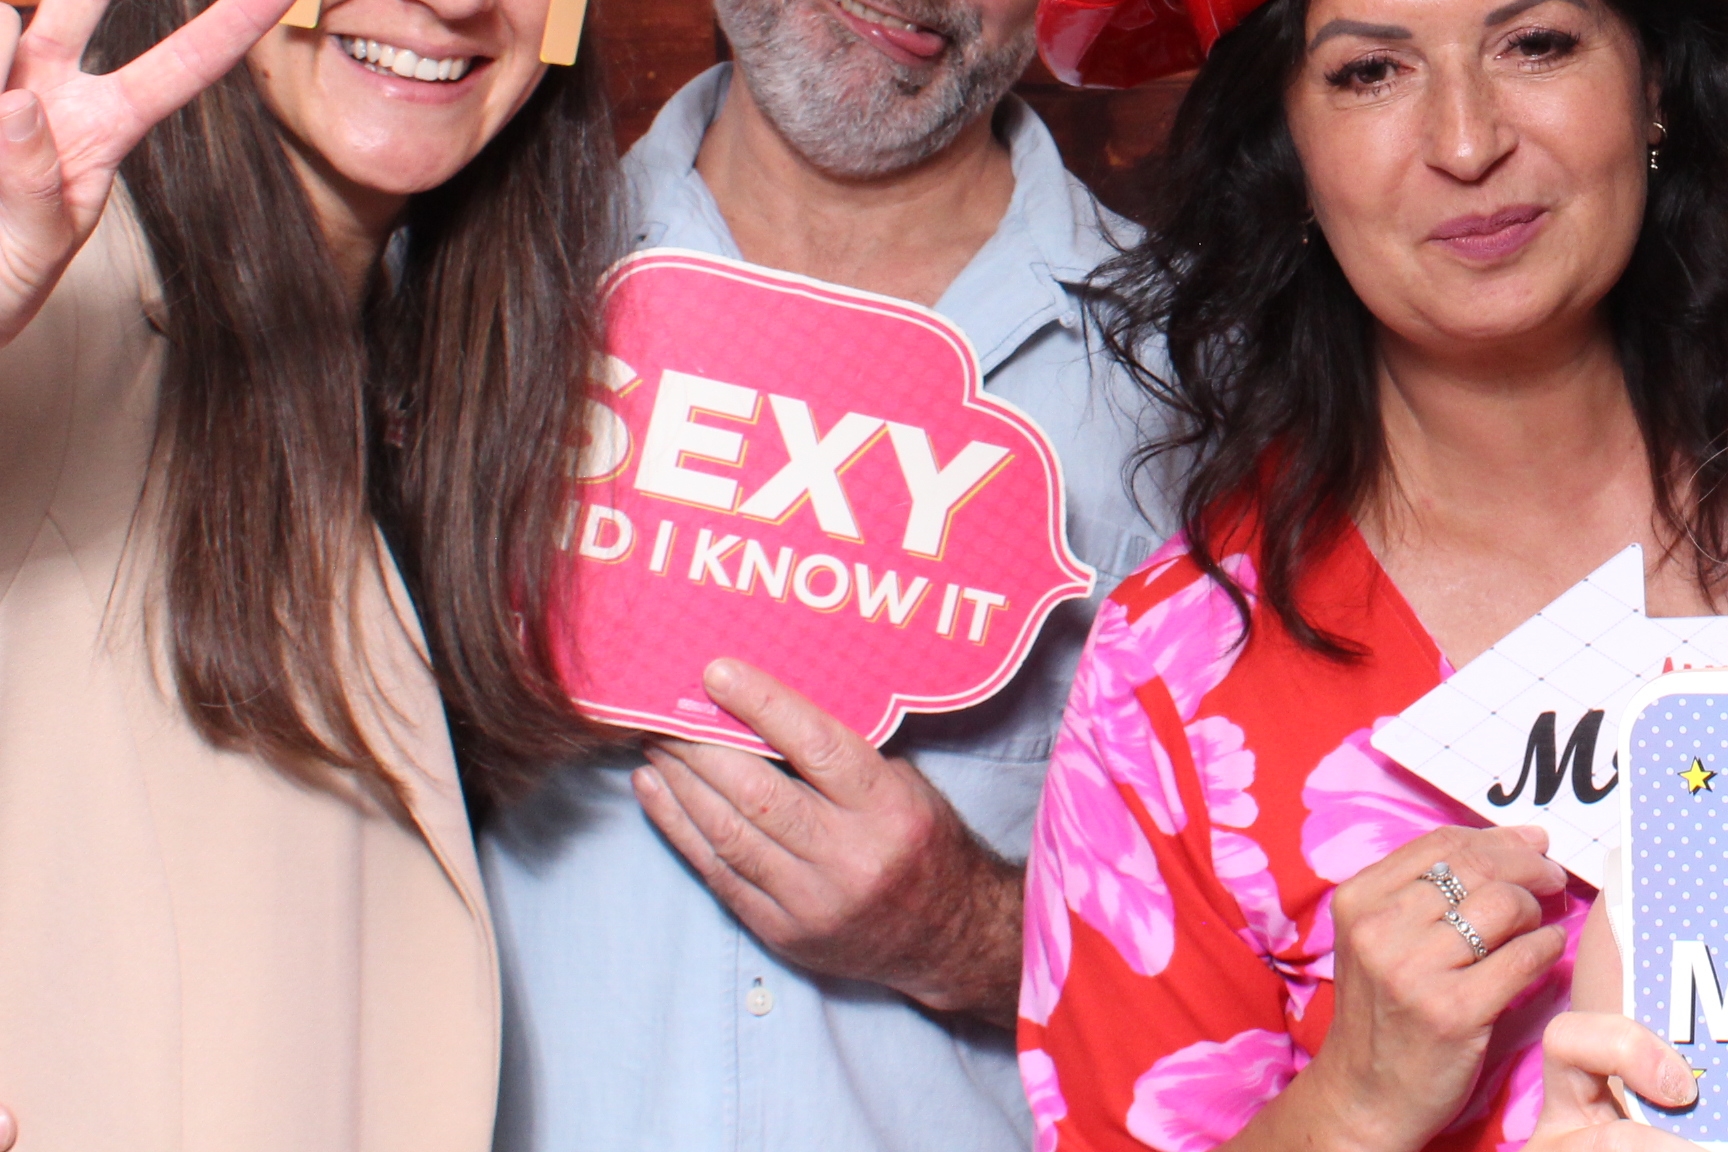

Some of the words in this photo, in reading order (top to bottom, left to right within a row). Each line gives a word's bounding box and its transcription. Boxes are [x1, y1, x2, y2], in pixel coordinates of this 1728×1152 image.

[649, 519, 678, 578] I
[688, 528, 933, 628] KNOW
[936, 582, 1010, 646] IT
